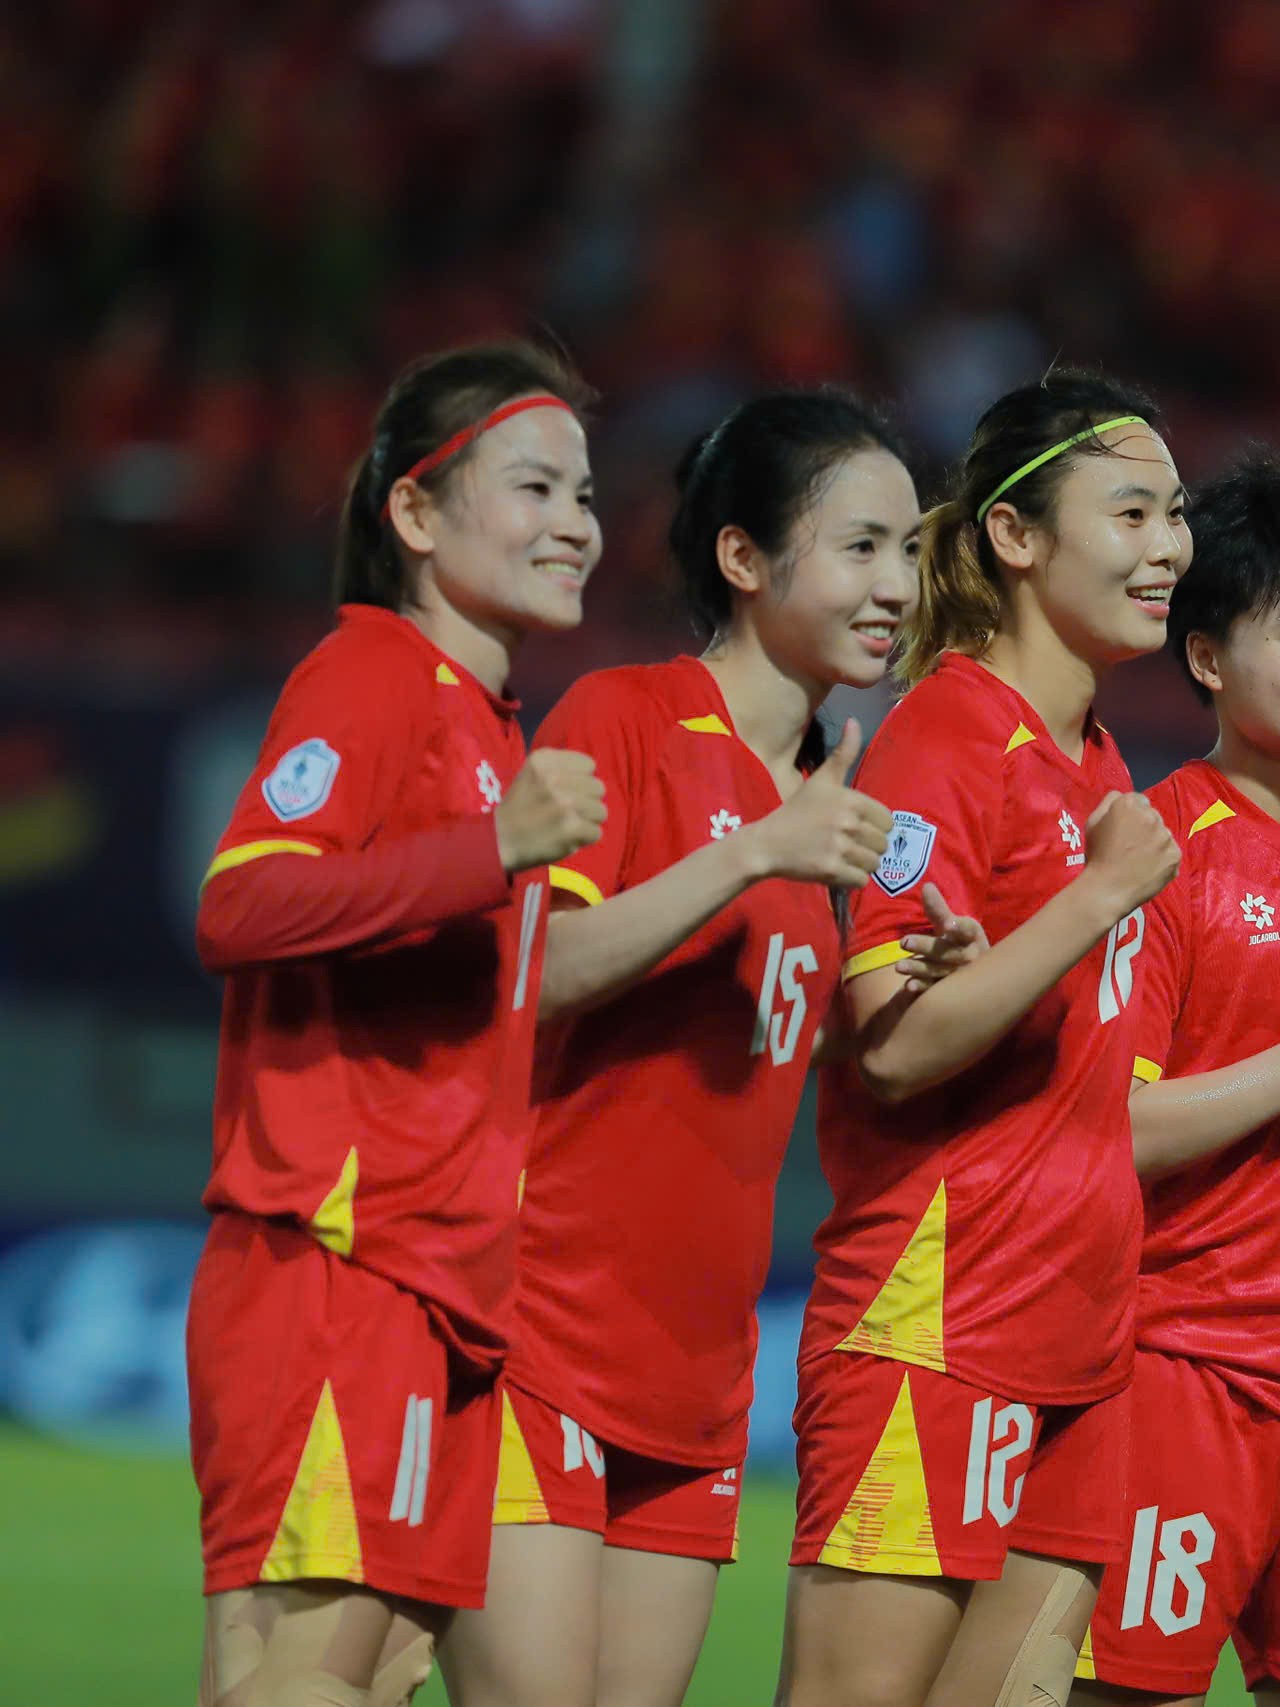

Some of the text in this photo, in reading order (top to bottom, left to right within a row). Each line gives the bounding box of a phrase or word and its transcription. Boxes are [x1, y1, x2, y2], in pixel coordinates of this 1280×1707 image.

[882, 857, 910, 868] MSIG
[883, 871, 905, 880] CUP
[894, 813, 917, 824] ASEAN
[512, 882, 543, 1012] 11
[750, 932, 819, 1067] 15
[1098, 906, 1145, 1025] 12
[389, 1393, 433, 1527] 11
[962, 1396, 1034, 1528] 12
[1121, 1505, 1218, 1638] 18
